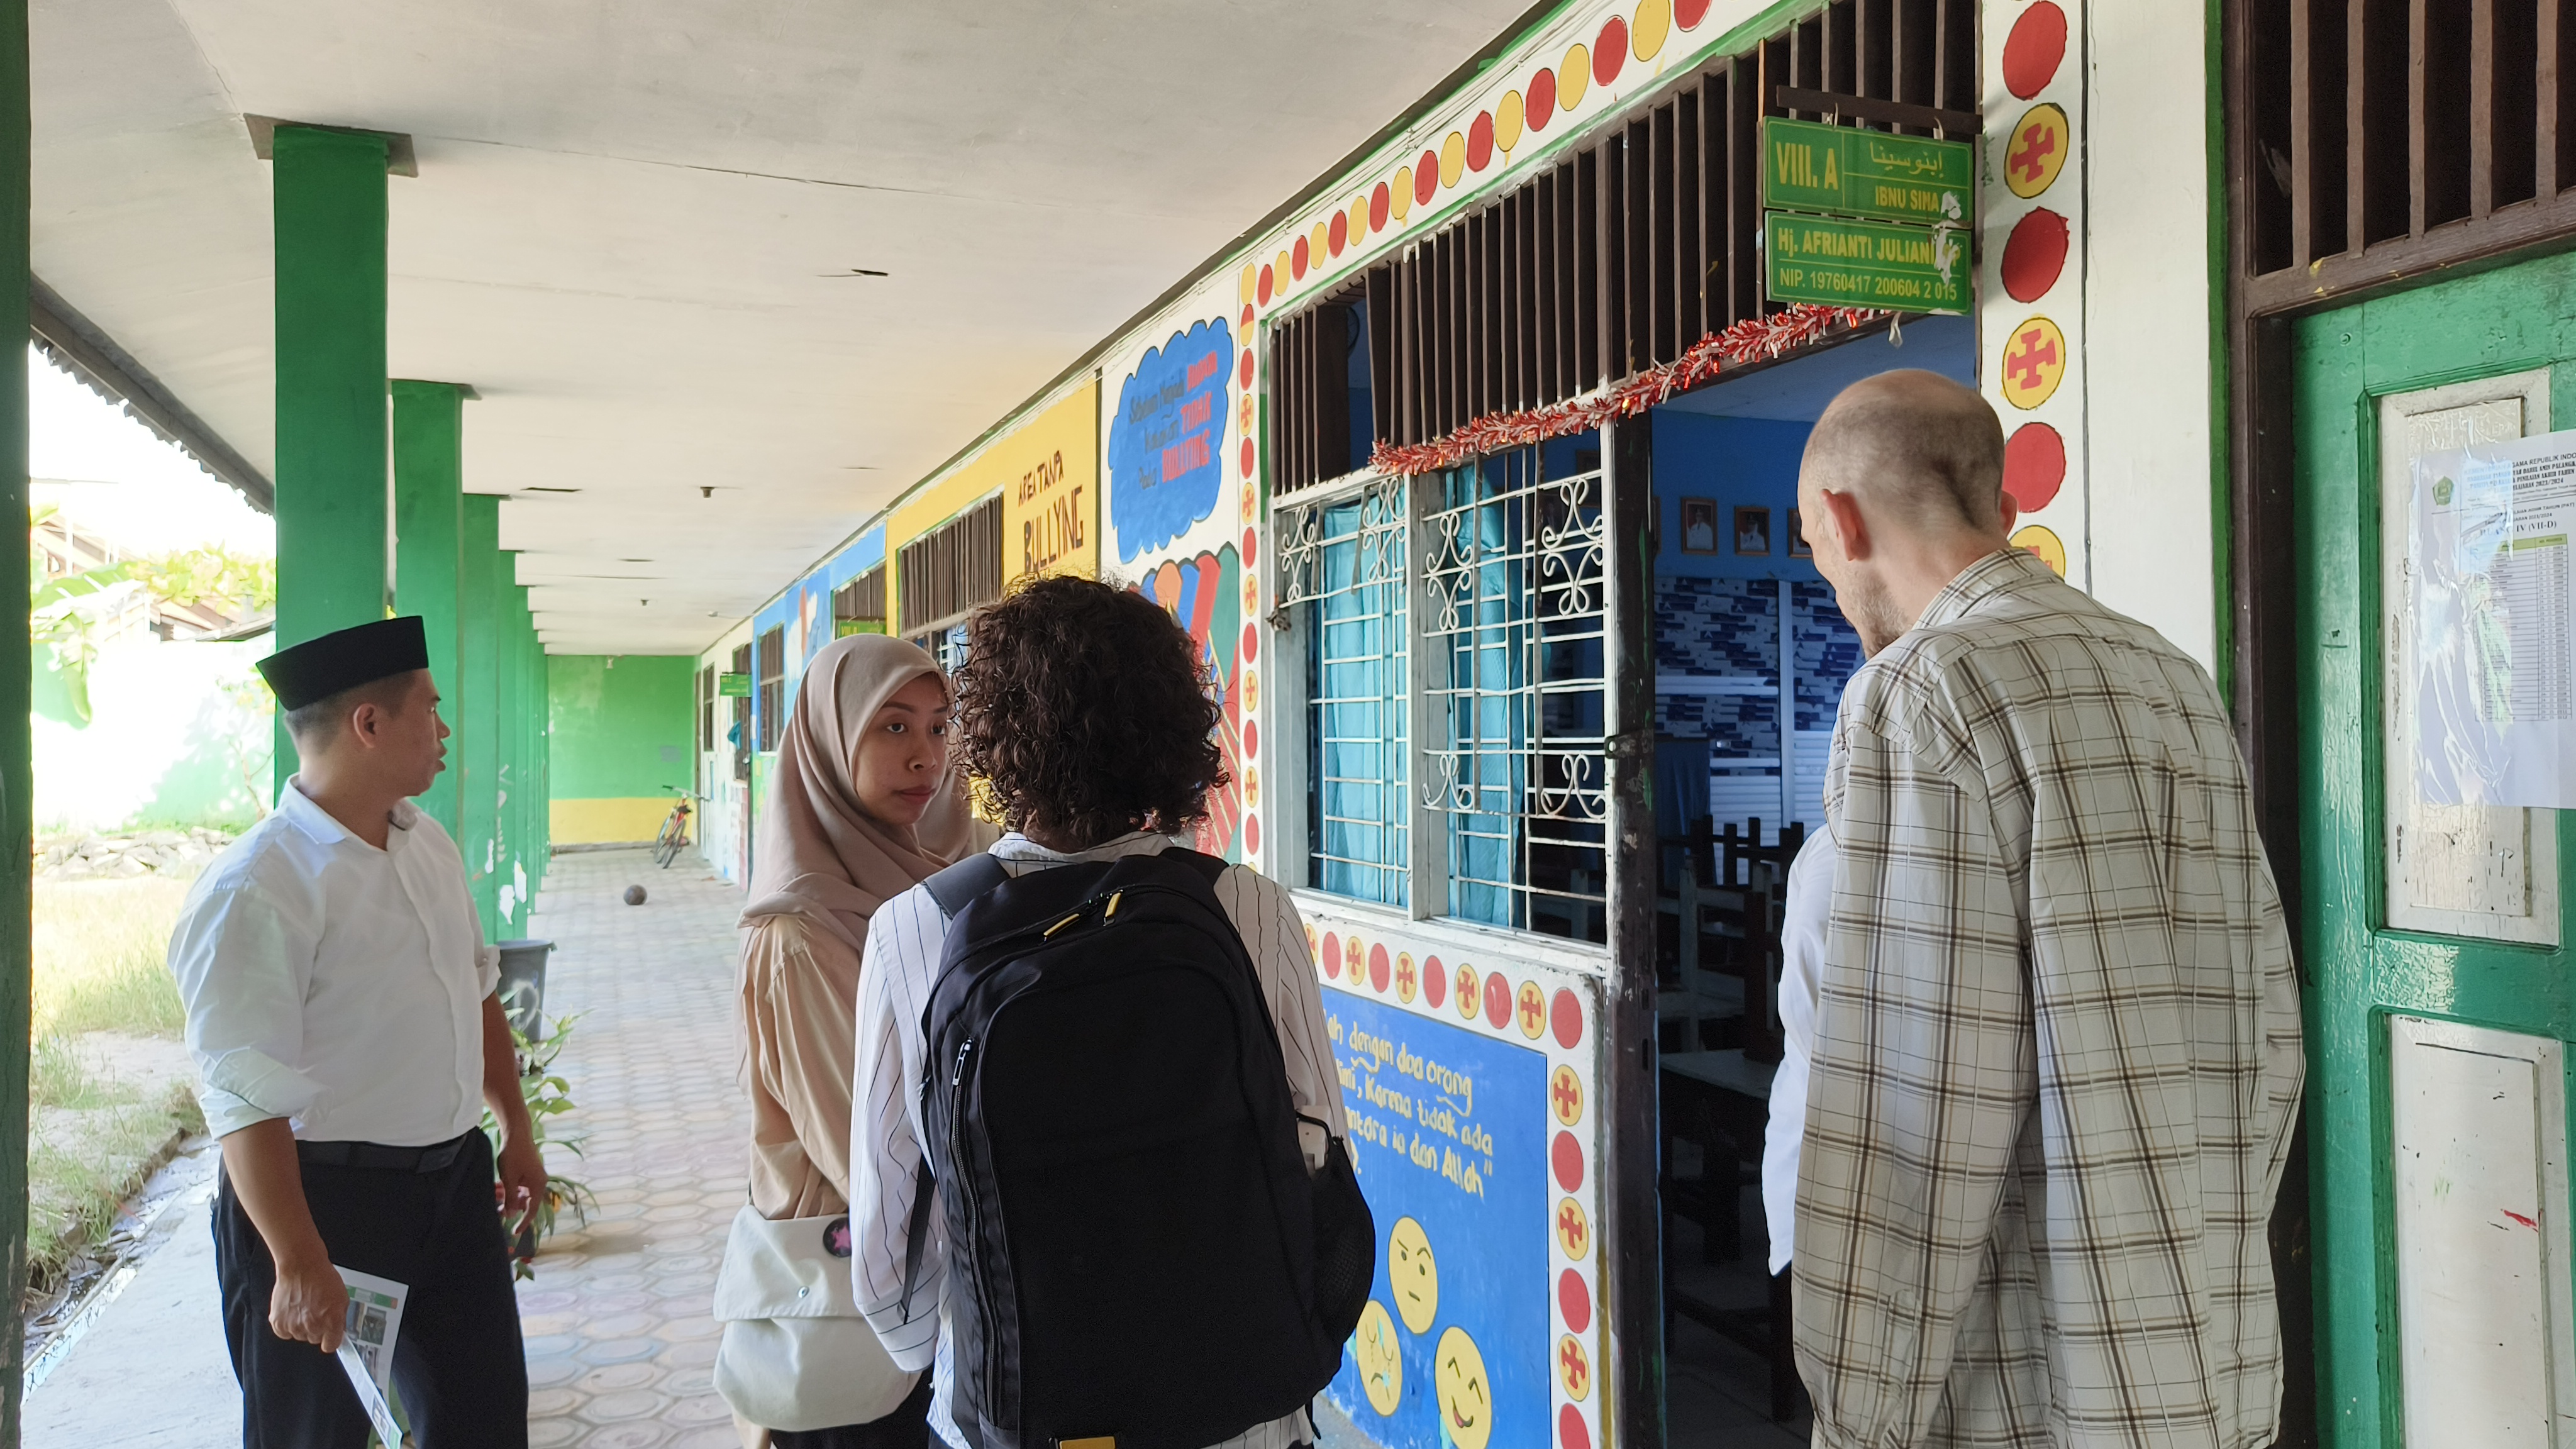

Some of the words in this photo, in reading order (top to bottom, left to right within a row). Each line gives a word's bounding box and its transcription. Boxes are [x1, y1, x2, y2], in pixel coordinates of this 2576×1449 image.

[1776, 142, 1818, 188] VIII.
[1824, 148, 1838, 191] A
[1875, 186, 1906, 209] IBNU
[1910, 189, 1940, 213] SINA
[1778, 227, 1799, 258] Hj.
[1802, 230, 1872, 260] AFRIANTI
[1780, 267, 1806, 289] NIP.
[1809, 271, 1871, 294] 19760417
[1875, 276, 1920, 298] 200604
[1924, 280, 1931, 299] 2
[1935, 282, 1958, 301] 015
[1180, 391, 1213, 435] TIDAK
[1036, 449, 1064, 494] TANPA
[1162, 428, 1211, 484] BULLYING
[2516, 523, 2526, 533] IV
[2528, 520, 2557, 532] (VII-D)
[1323, 1008, 1344, 1045] ah
[1349, 1021, 1394, 1074] dengan
[1396, 1041, 1424, 1080] doa
[1426, 1060, 1473, 1118] orang
[1365, 1074, 1413, 1119] Karena
[1416, 1099, 1458, 1140] tidak
[1460, 1122, 1494, 1157] ada
[1392, 1124, 1406, 1155] ia
[1409, 1131, 1438, 1172] dan
